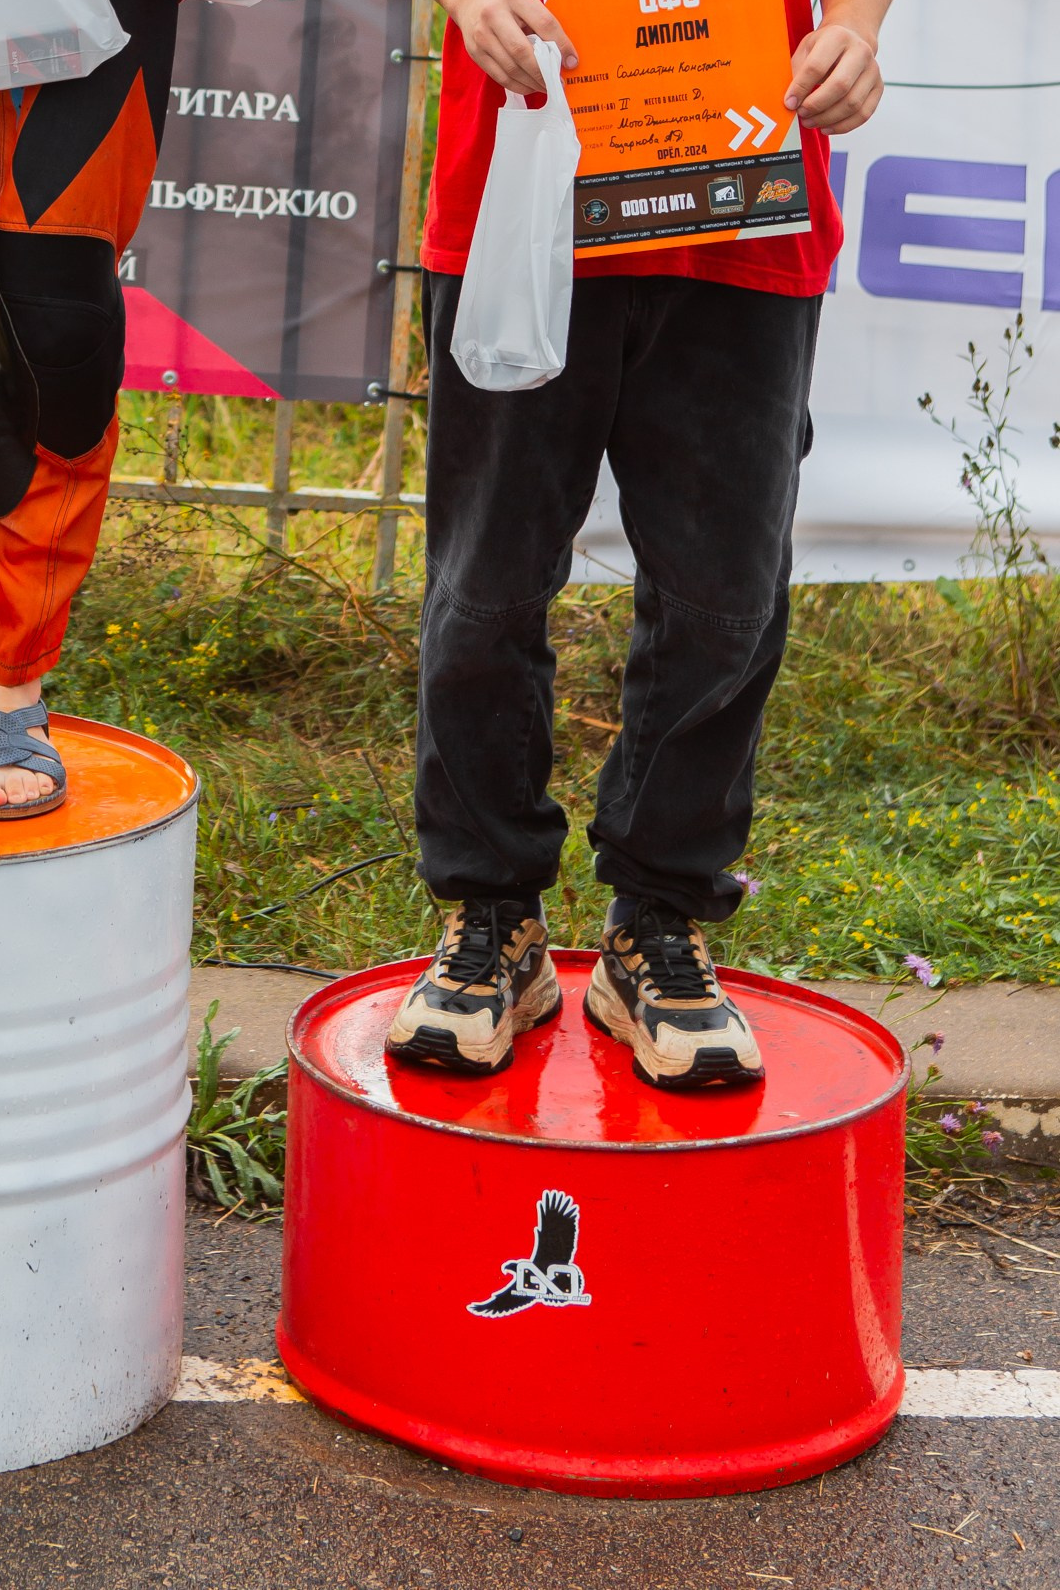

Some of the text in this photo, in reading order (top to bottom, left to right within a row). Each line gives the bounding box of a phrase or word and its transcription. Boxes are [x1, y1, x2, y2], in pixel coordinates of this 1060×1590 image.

[635, 18, 710, 49] ДИПЛОМ
[566, 72, 609, 86] НАГРАЖДАЕТСЯ
[644, 96, 662, 106] МЕСТО
[668, 93, 688, 103] КЛАССЕ
[684, 144, 708, 157] 2024
[650, 196, 669, 215] ТД
[670, 192, 696, 211] ИТА
